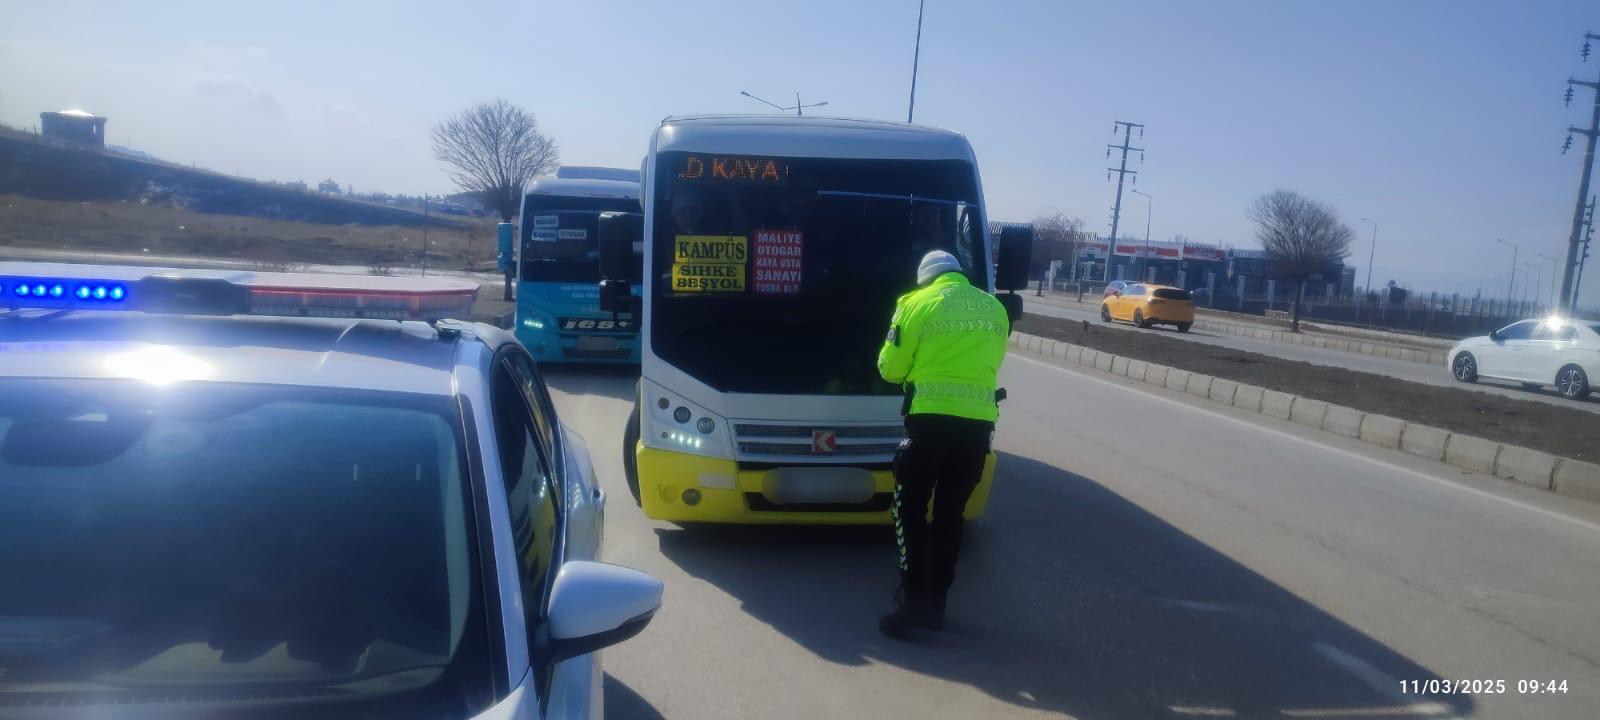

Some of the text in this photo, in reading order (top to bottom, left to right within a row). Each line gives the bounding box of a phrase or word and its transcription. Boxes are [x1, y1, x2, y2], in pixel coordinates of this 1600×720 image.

[678, 237, 745, 260] KAMPÜS
[757, 245, 801, 256] OTOGAR
[756, 257, 801, 269] KAYA USTA
